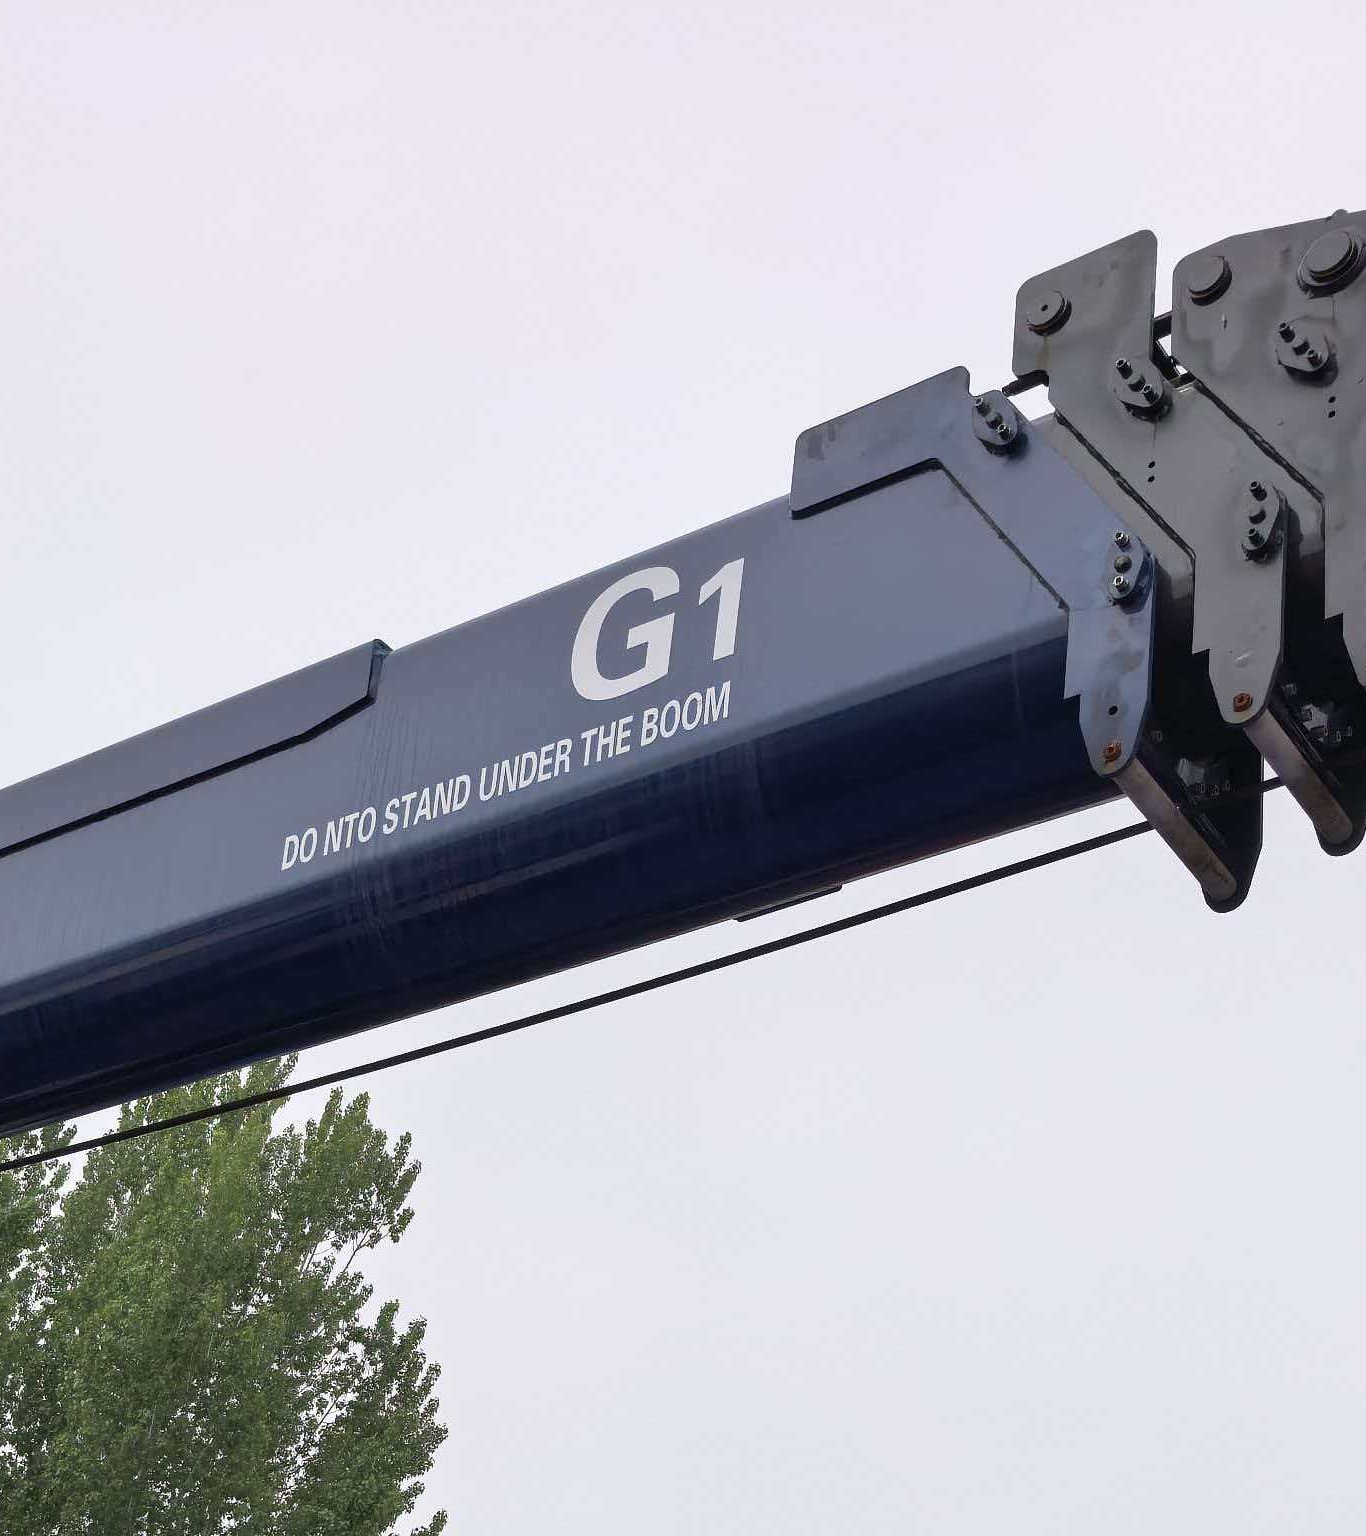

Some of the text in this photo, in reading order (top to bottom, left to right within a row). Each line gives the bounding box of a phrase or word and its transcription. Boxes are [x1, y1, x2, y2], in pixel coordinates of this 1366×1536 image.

[571, 557, 745, 701] G1
[281, 679, 731, 871] DO NTO STAND UNDER THE BOOM
